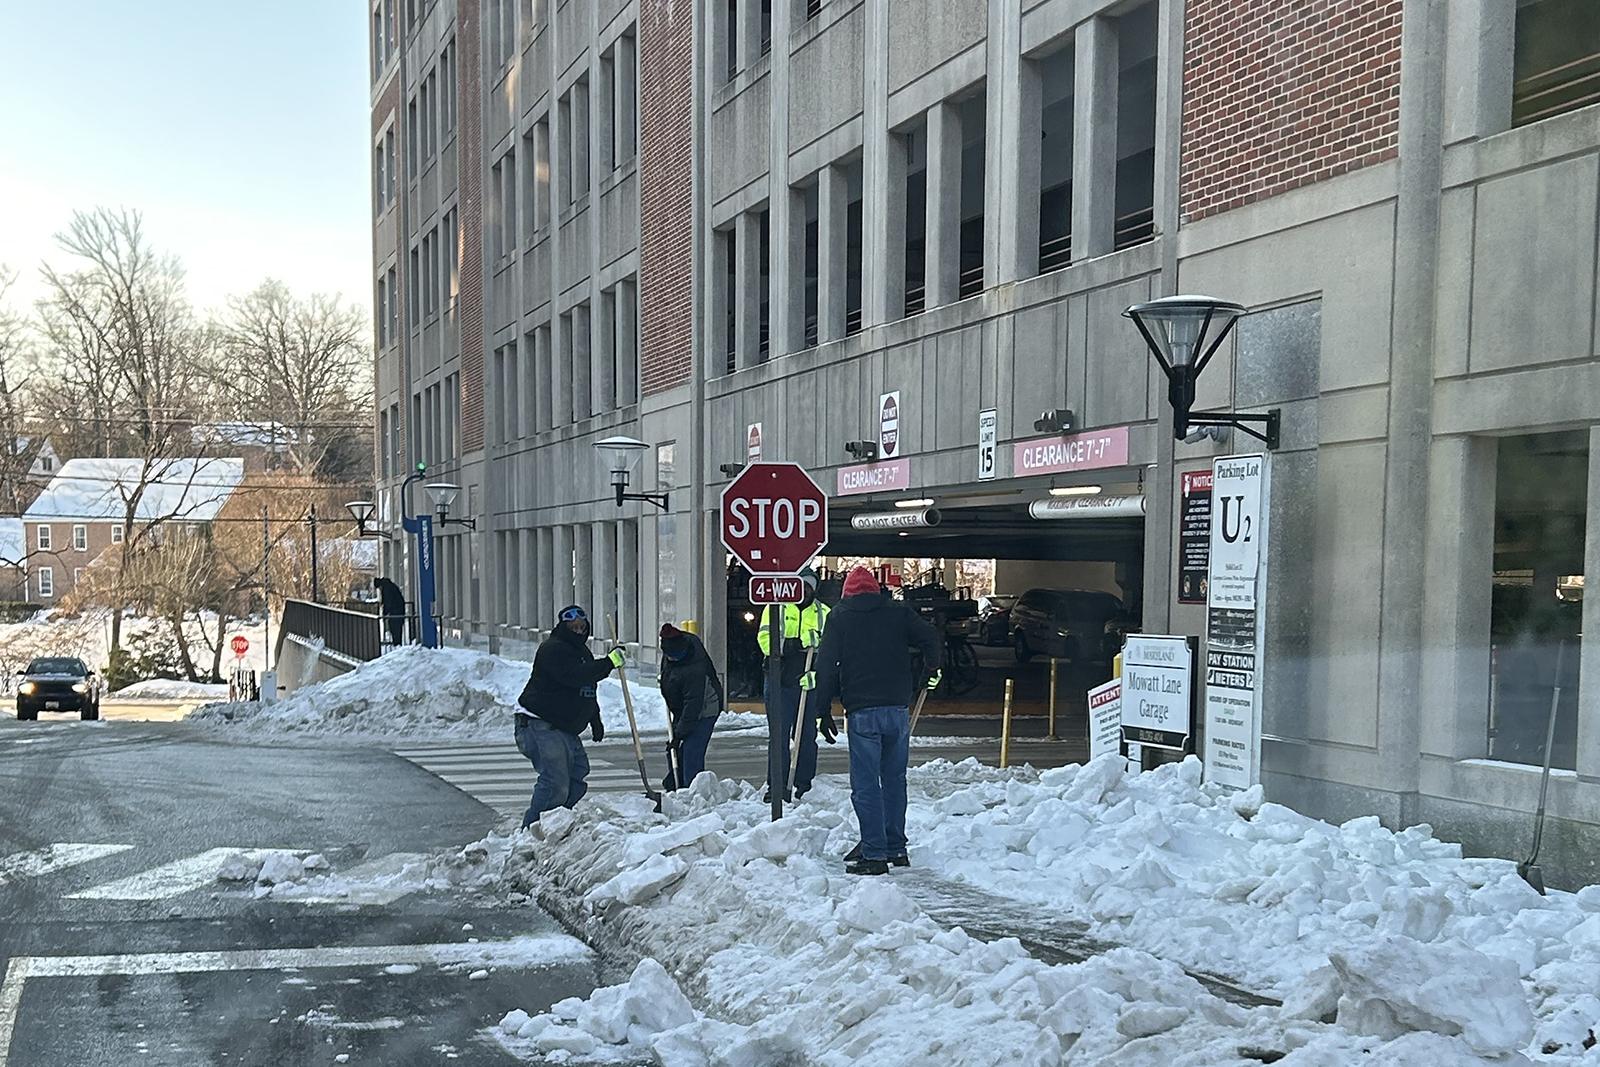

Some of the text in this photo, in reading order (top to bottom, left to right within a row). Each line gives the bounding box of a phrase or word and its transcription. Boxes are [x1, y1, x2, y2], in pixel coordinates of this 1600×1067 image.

[981, 416, 995, 428] SPEED
[981, 431, 994, 443] LIMIT
[981, 447, 993, 473] 15
[1023, 441, 1084, 469] CLEARANCE
[843, 468, 883, 490] CLEARANCE
[1217, 462, 1259, 480] Parking Lot
[1192, 474, 1213, 488] NOTIC
[729, 497, 821, 539] STOP
[859, 515, 918, 528] DO NOT ENTER
[422, 519, 430, 571] EMERGENCY
[756, 582, 798, 599] 4-WAY
[231, 639, 249, 651] STOP
[1209, 652, 1254, 670] PAY STATION
[1128, 671, 1182, 694] Mowatt Lane
[1215, 671, 1246, 688] METERS
[1091, 686, 1121, 707] ATTENT
[1139, 698, 1169, 724] Garage
